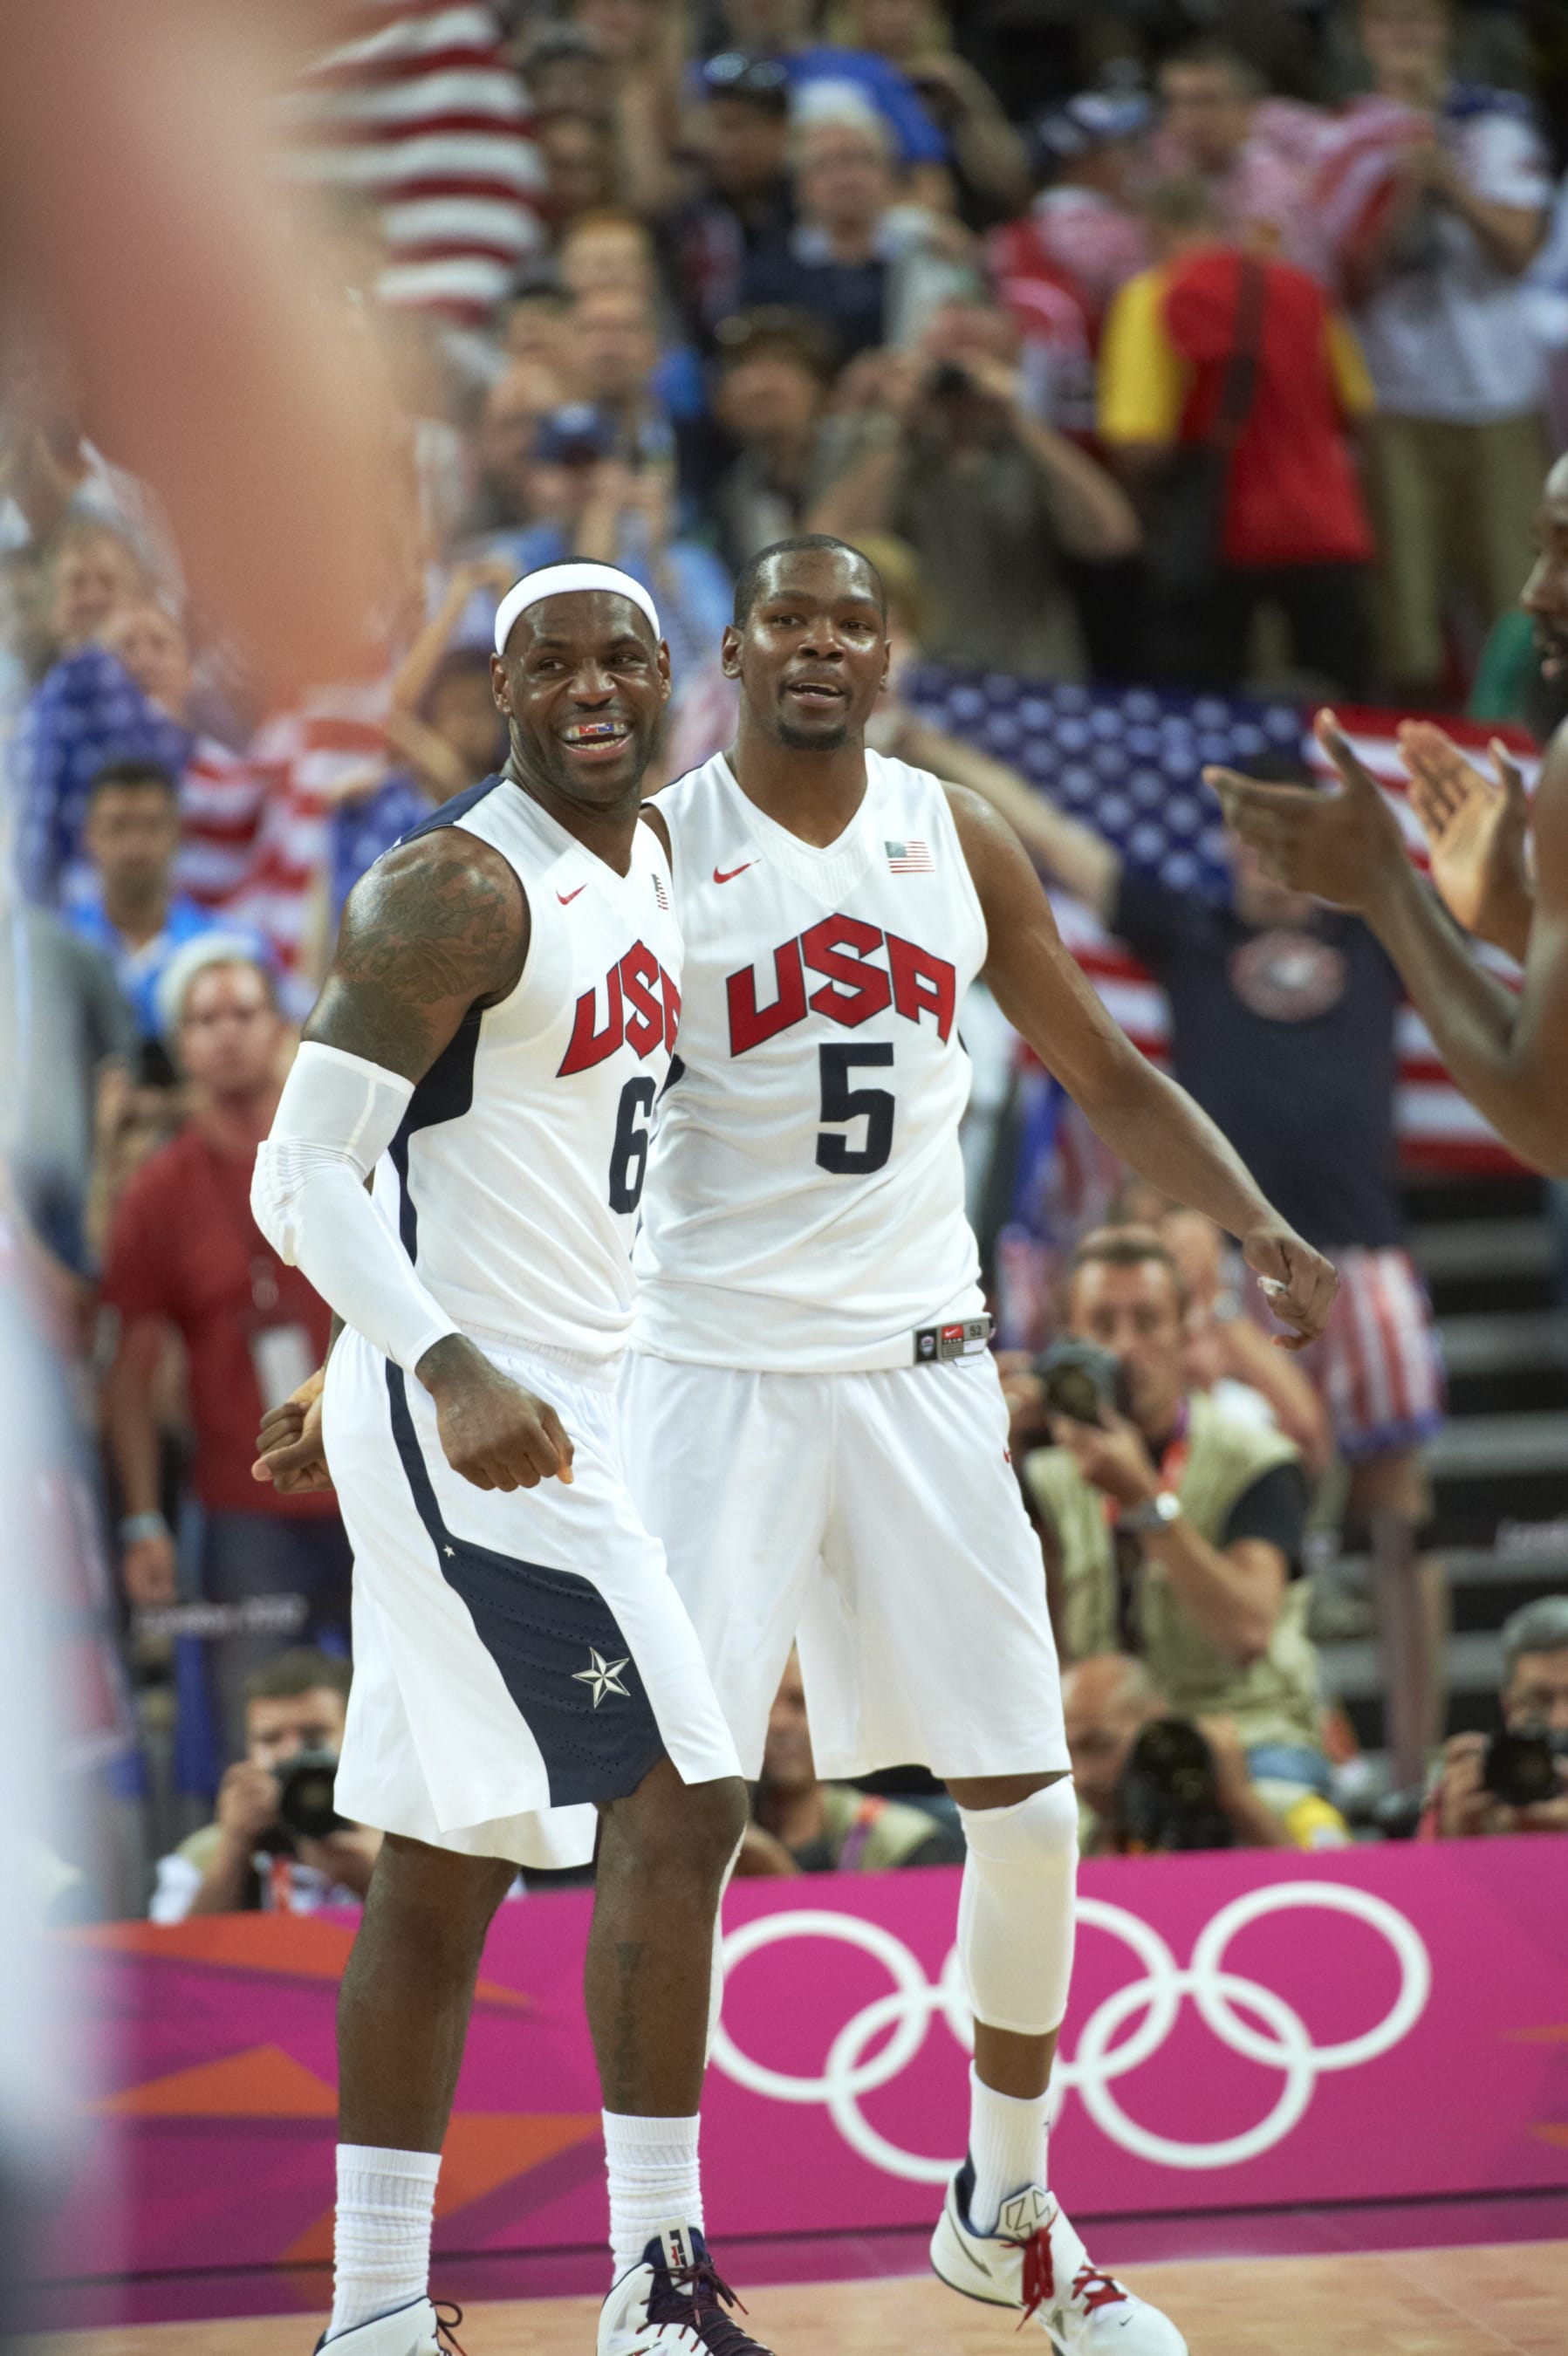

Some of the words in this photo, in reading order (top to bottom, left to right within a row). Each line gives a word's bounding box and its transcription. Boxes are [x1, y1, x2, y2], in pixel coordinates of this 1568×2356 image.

[726, 913, 955, 1058] USA
[608, 1077, 656, 1214] 6
[816, 1042, 894, 1175] 5
